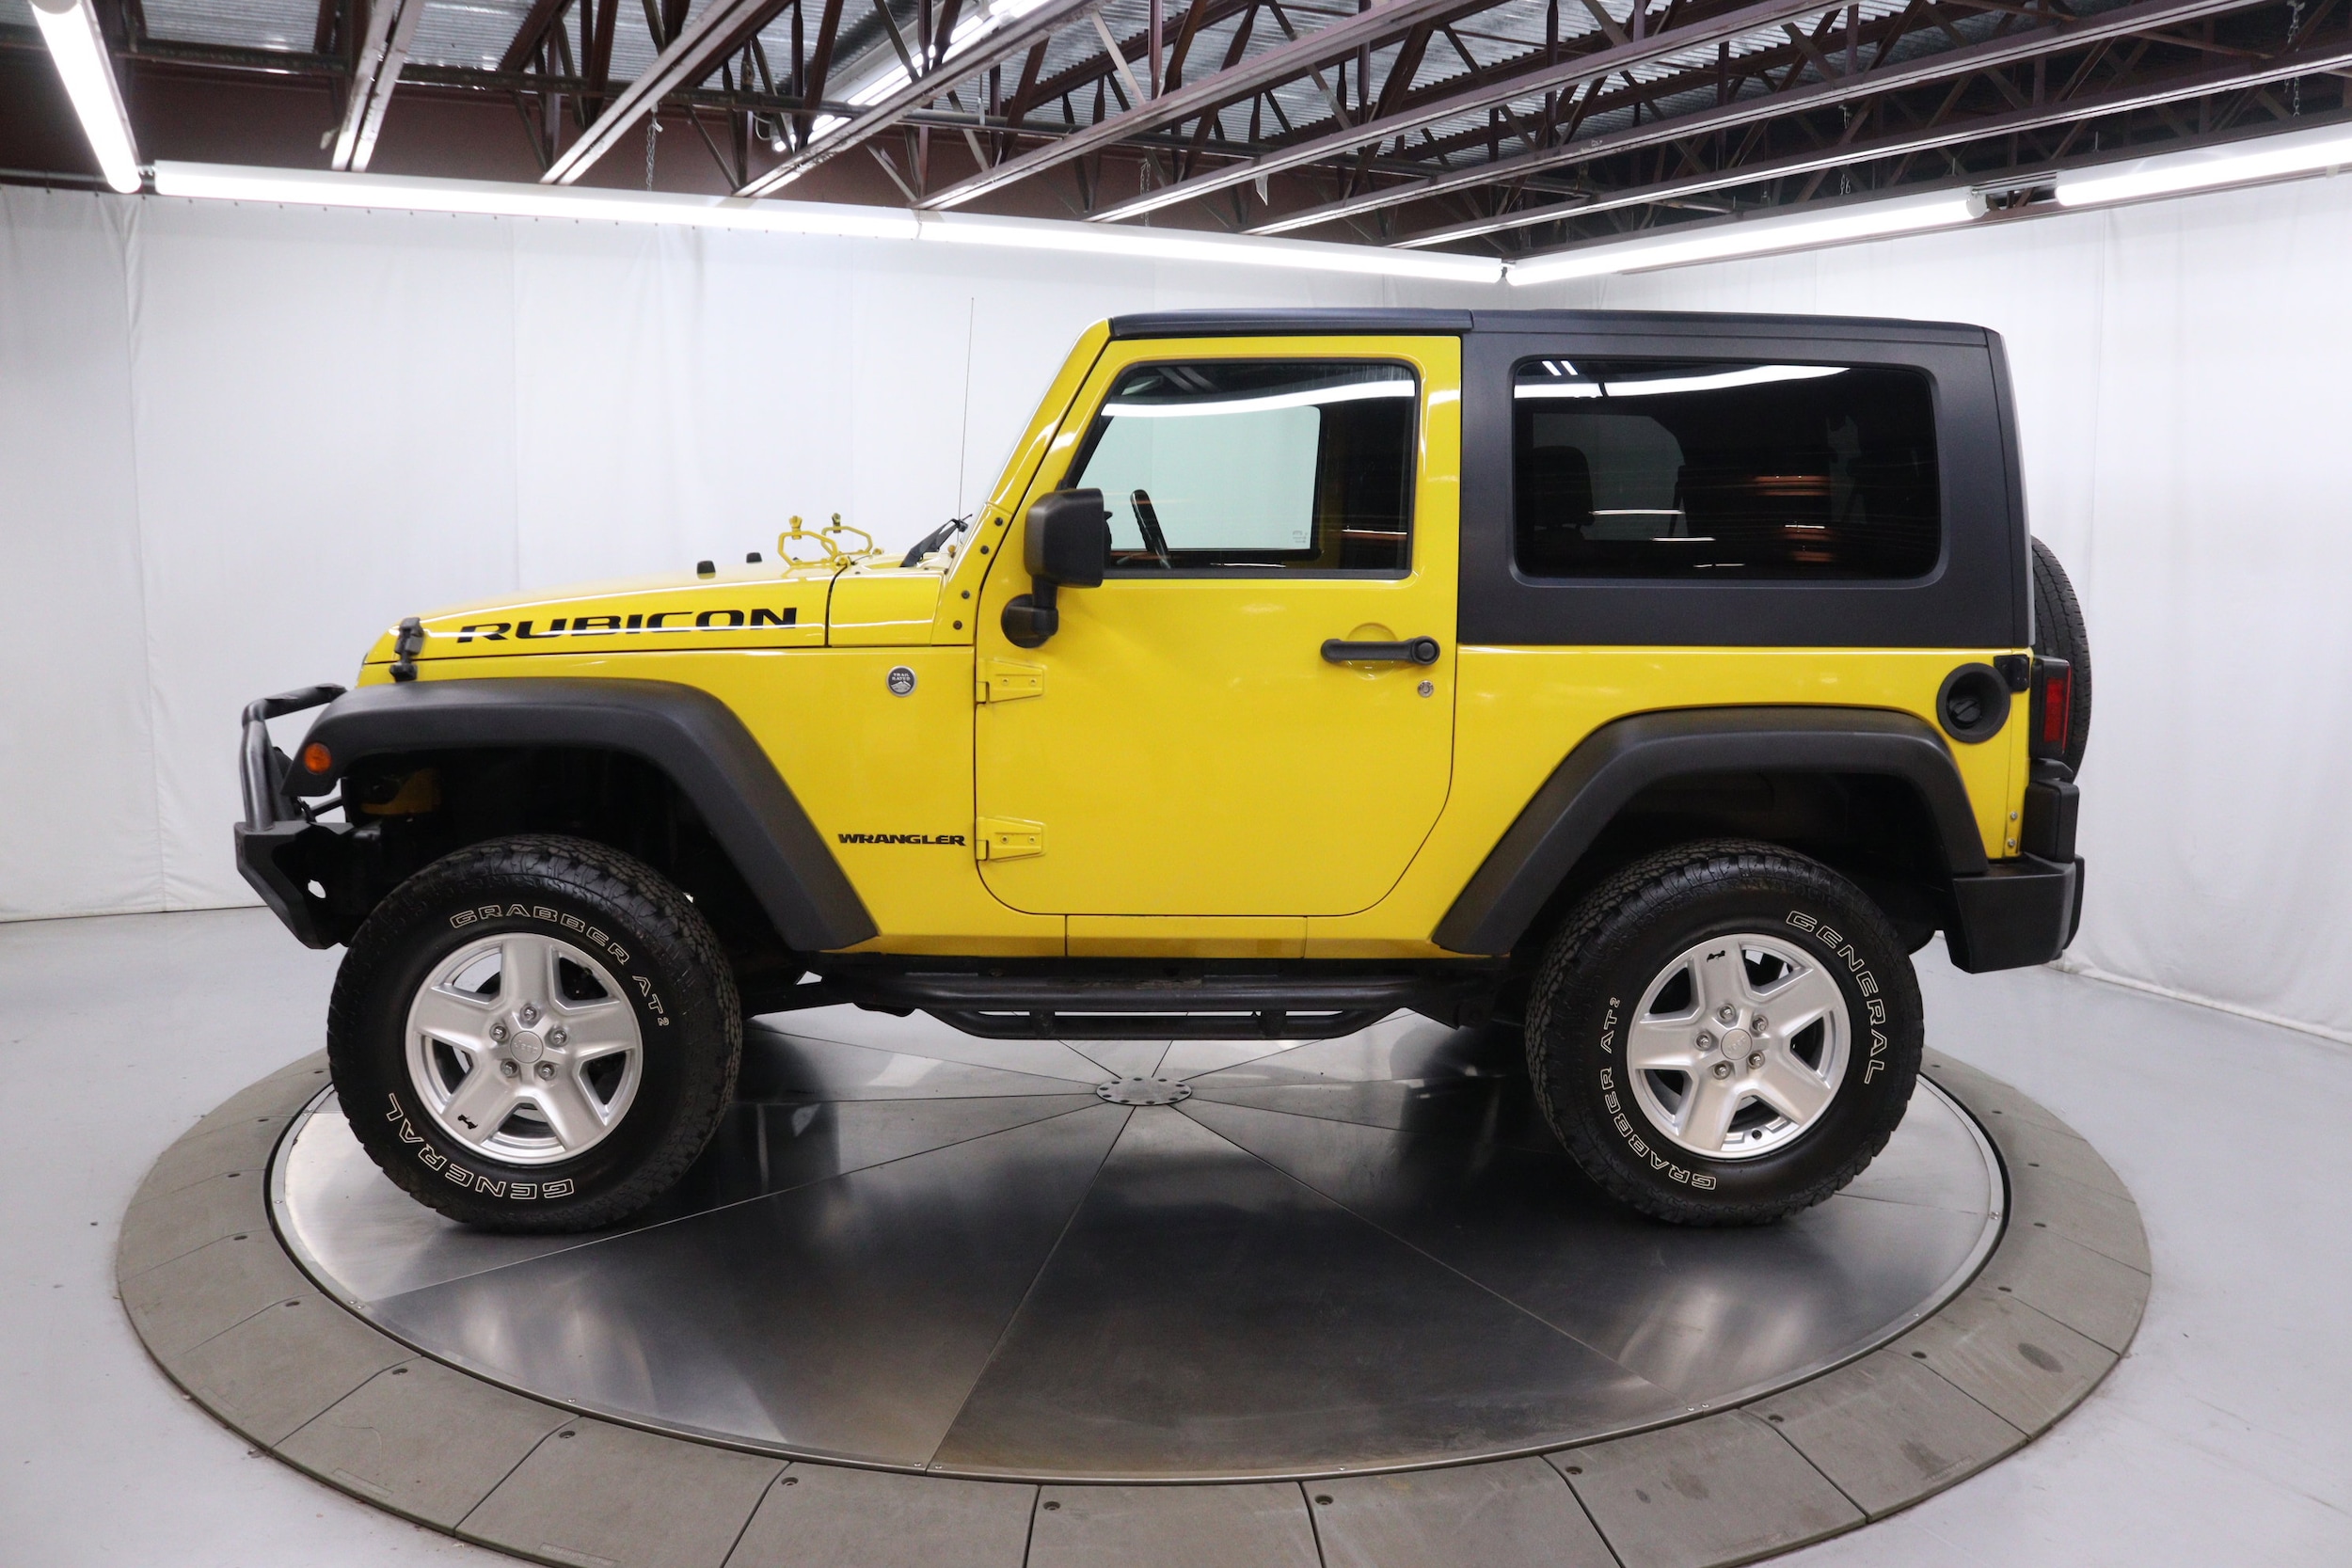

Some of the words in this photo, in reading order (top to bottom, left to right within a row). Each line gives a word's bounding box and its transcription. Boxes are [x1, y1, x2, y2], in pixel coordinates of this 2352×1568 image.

[456, 607, 798, 643] RUBICON
[838, 833, 966, 847] WRANGLER
[450, 903, 629, 966] GRABBER
[1786, 910, 1887, 1085] GENERAL
[385, 1093, 575, 1200] GENERAL
[1599, 1068, 1717, 1191] GRABBER
